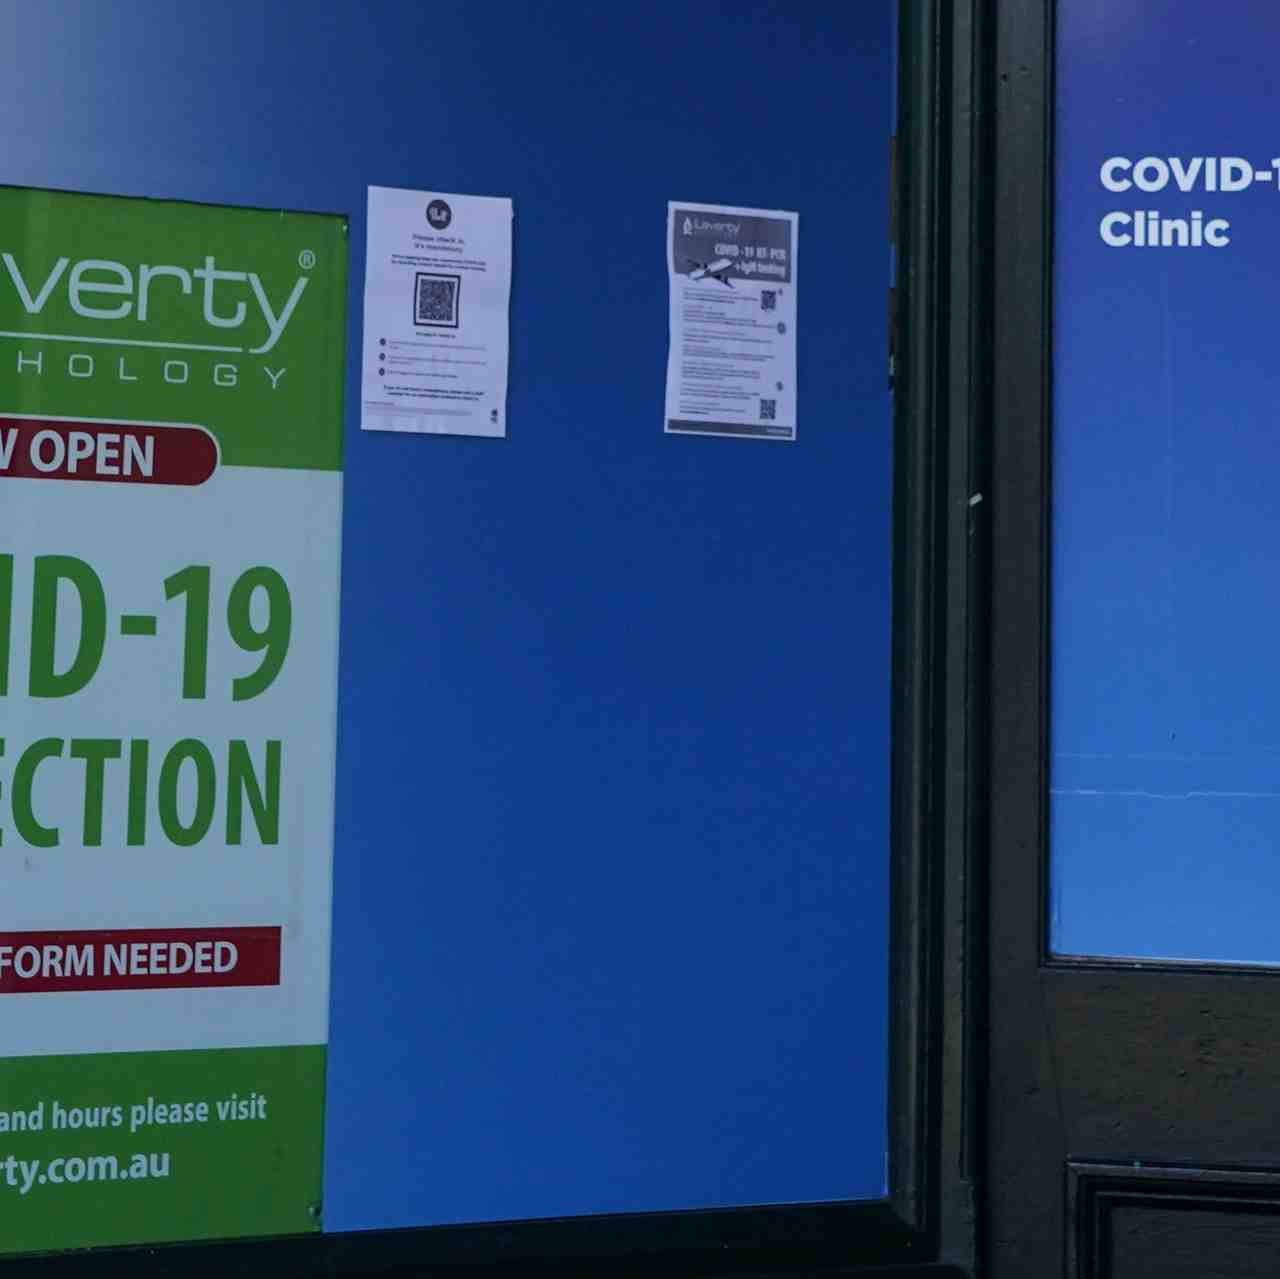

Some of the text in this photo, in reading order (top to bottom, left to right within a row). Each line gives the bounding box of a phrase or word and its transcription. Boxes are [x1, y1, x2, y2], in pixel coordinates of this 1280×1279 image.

[1099, 210, 1230, 249] Clinic
[29, 429, 155, 477] OPEN
[103, 940, 238, 976] NEEDED
[51, 1096, 122, 1130] hours
[129, 1094, 208, 1135] please
[216, 1091, 267, 1120] visit
